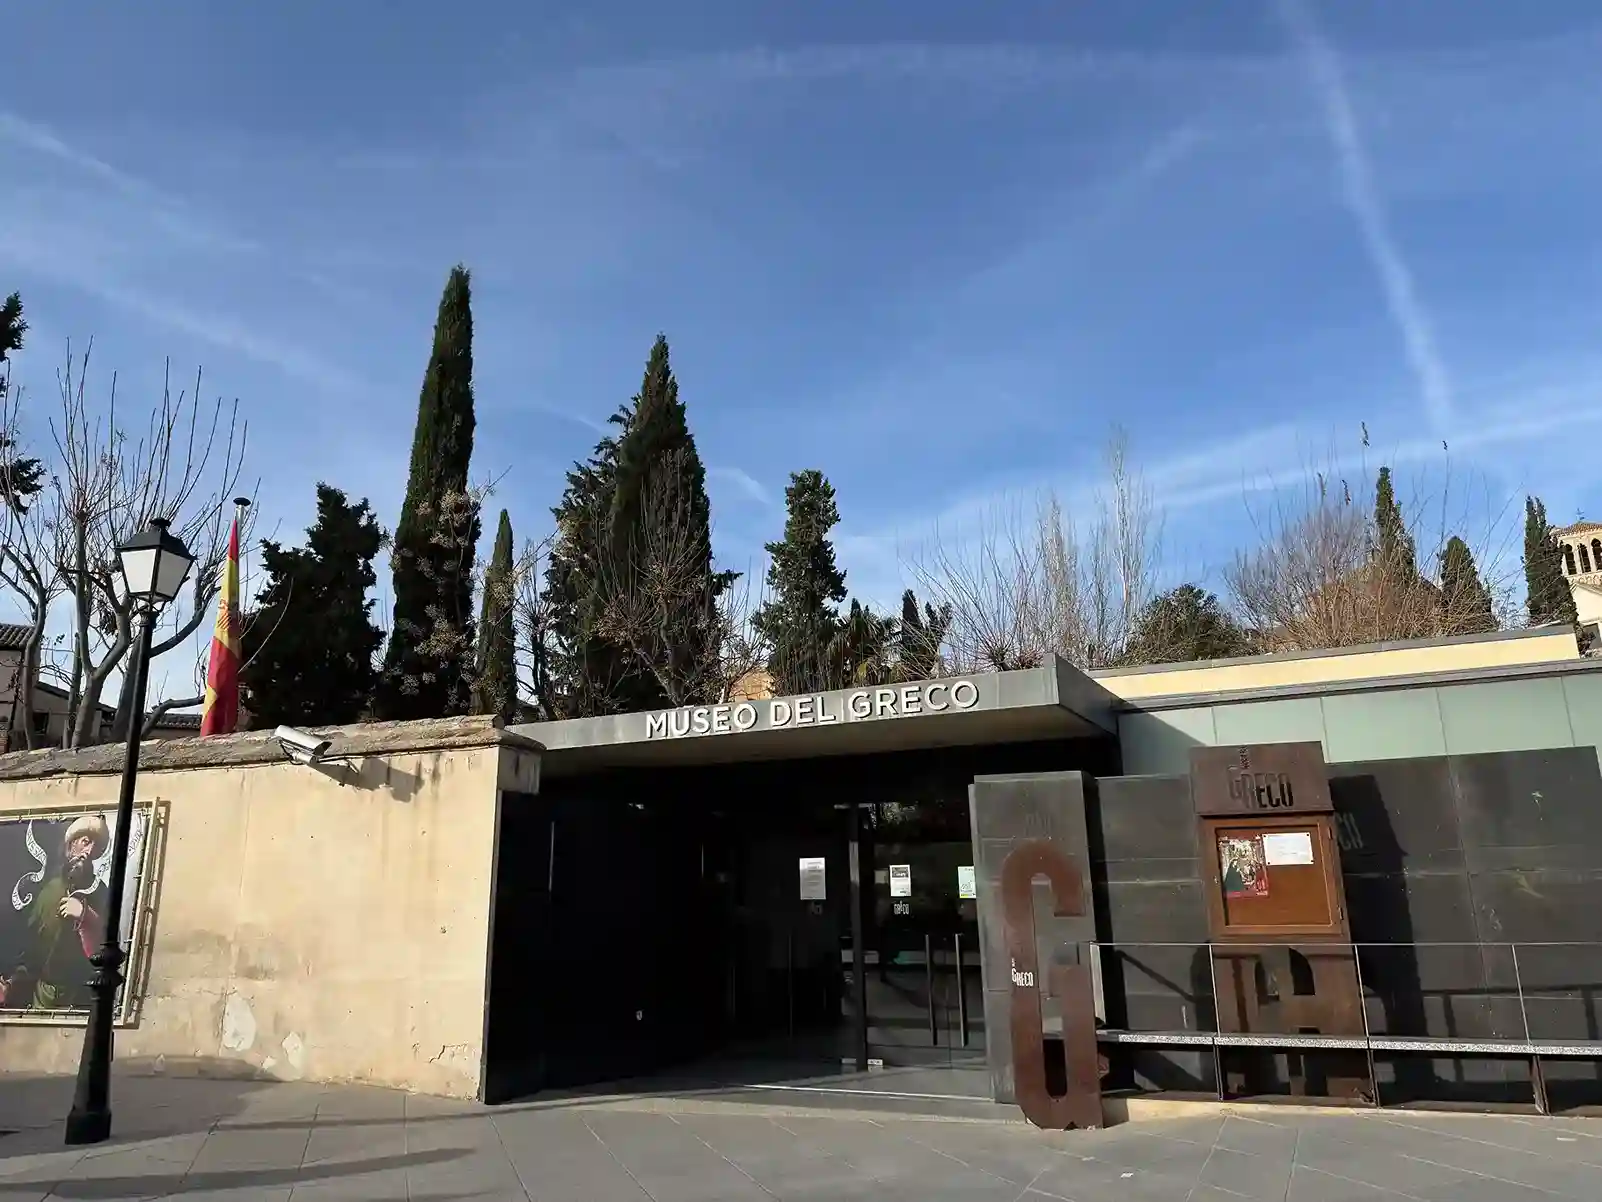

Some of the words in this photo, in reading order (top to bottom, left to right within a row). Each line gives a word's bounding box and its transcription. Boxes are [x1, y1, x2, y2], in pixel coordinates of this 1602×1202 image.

[646, 703, 757, 738] MUSEO
[769, 697, 835, 727] DEL
[847, 681, 979, 718] GRECO
[1227, 765, 1293, 809] GRECO
[1011, 967, 1034, 987] GRECO
